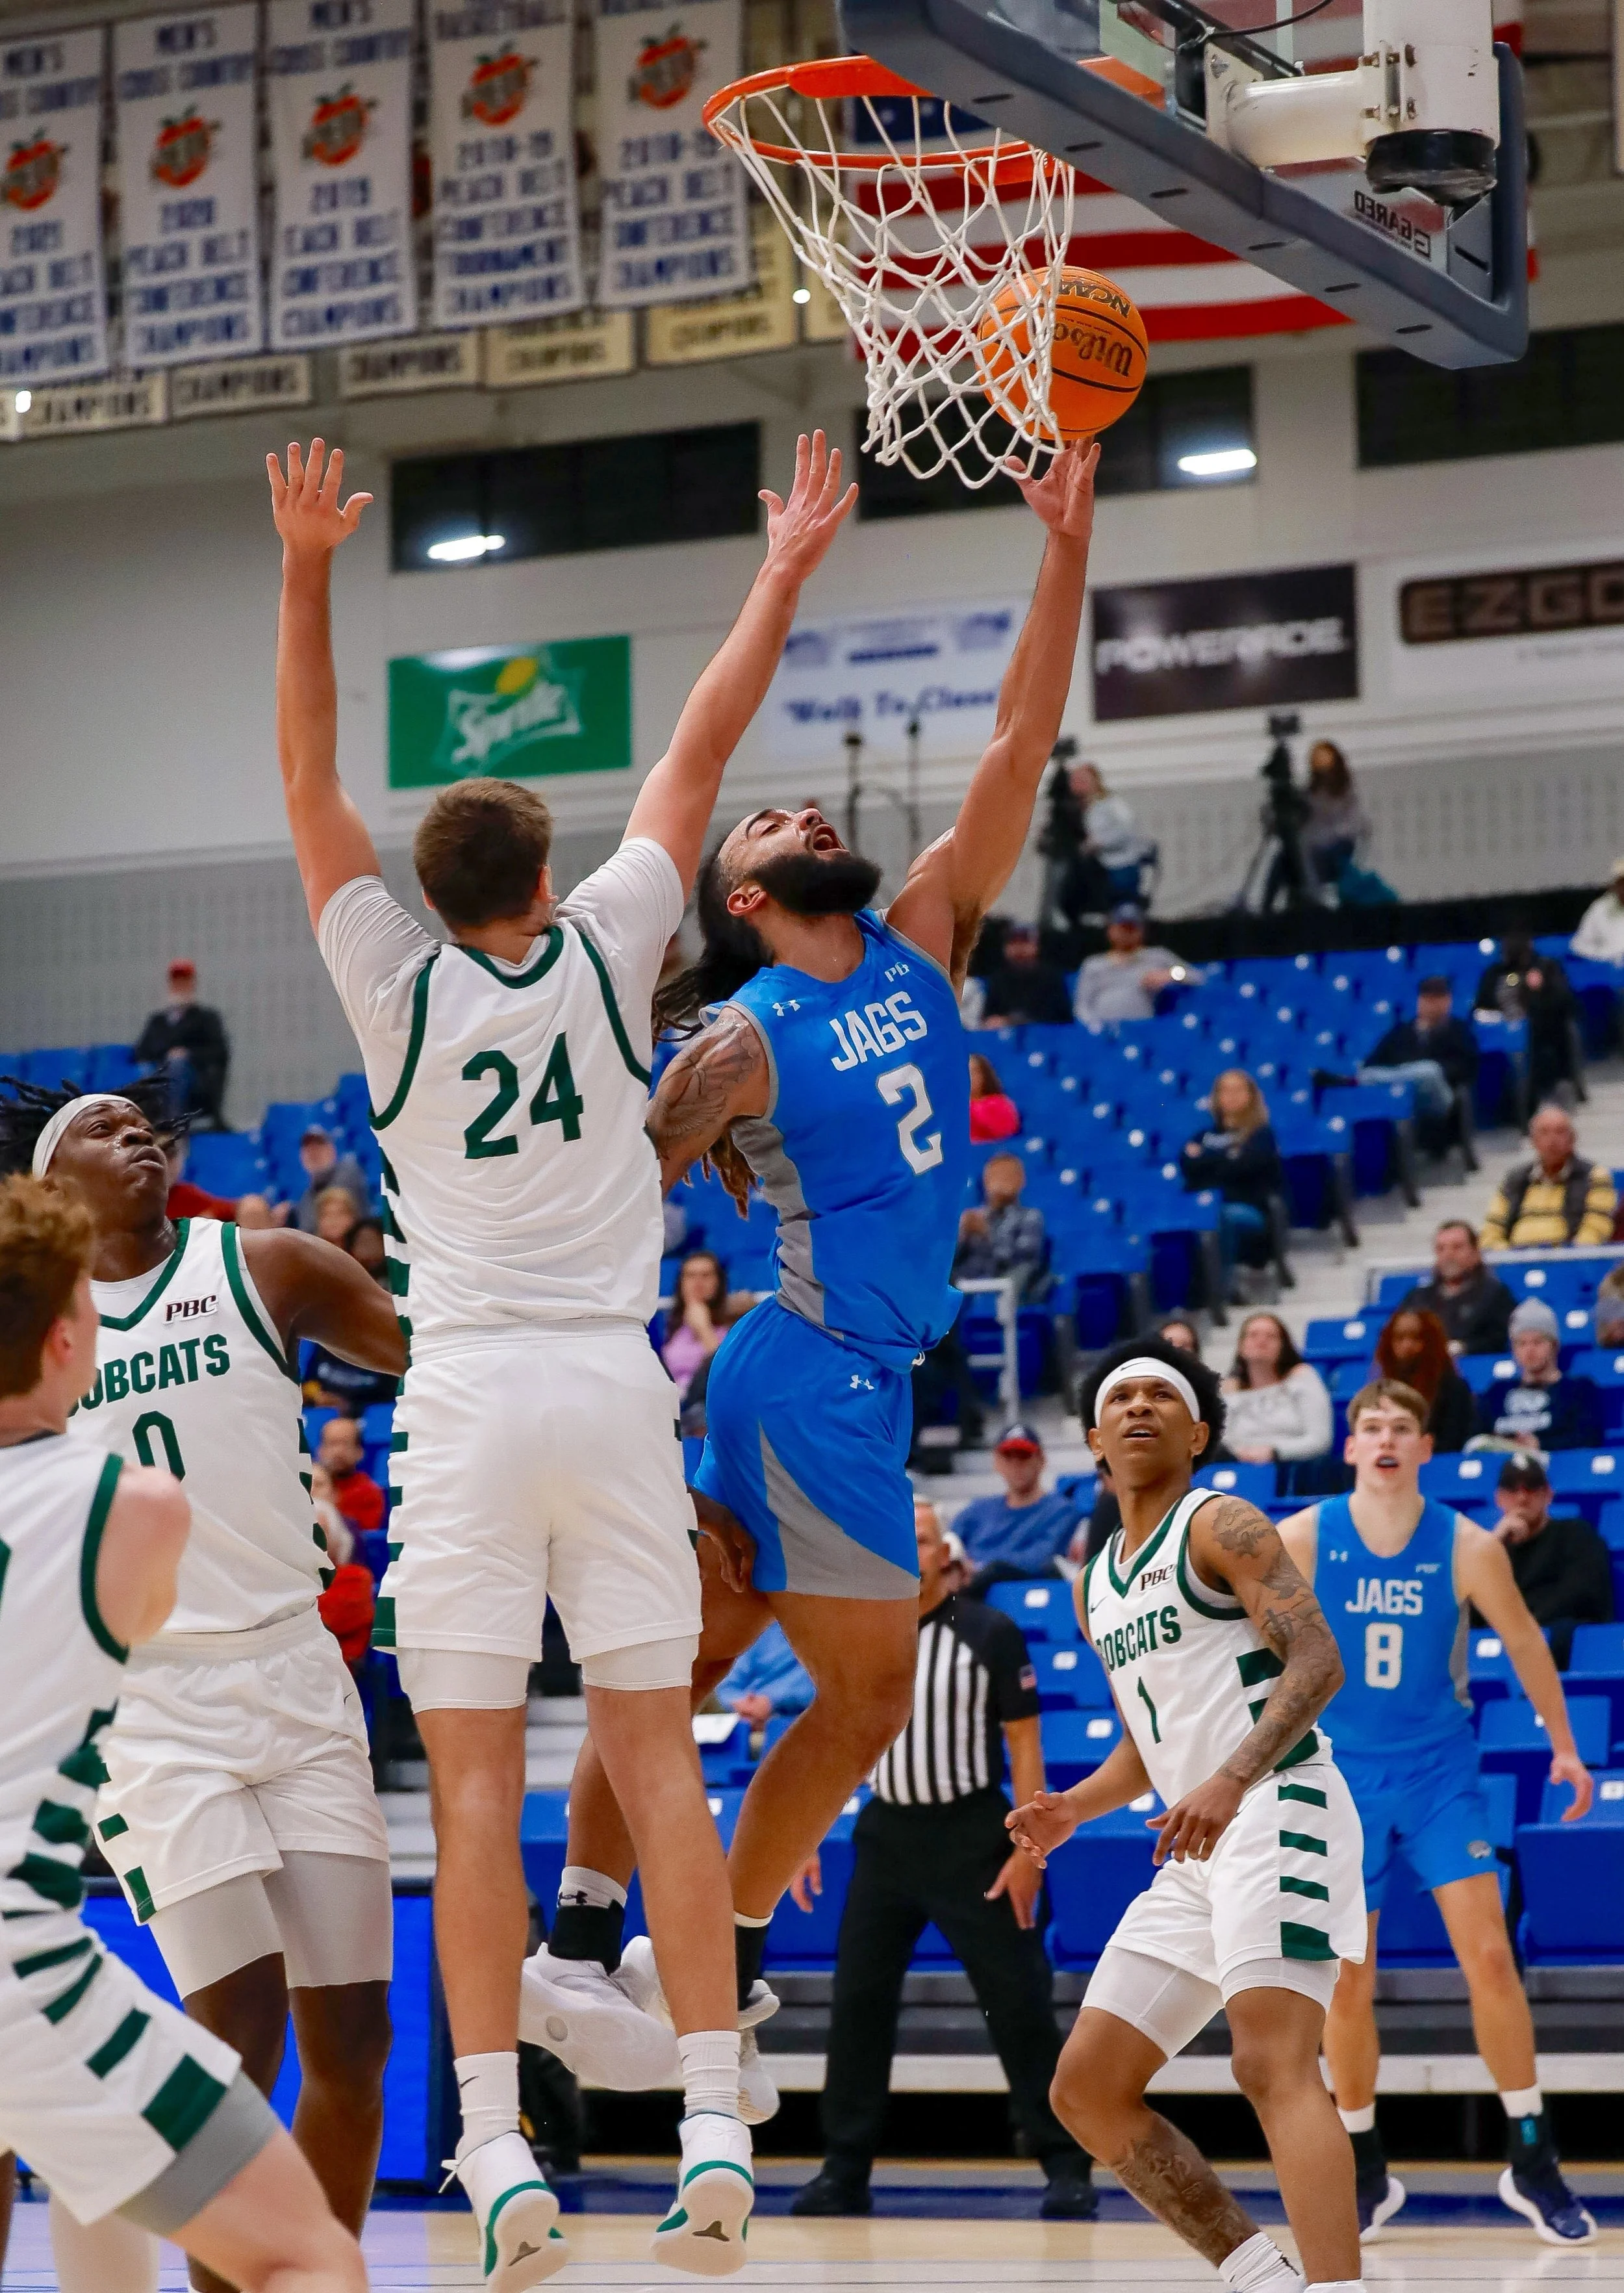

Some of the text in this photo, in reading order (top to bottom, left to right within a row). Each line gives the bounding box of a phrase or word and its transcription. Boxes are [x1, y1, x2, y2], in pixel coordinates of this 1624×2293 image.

[459, 131, 552, 172] 2018-19
[312, 177, 370, 214] 2019
[442, 157, 565, 203] PEACH BELT
[603, 163, 734, 210] PEACH BELT
[353, 209, 400, 246] BELT
[438, 198, 565, 241] CONFERENCE
[129, 228, 247, 274] PEACH BELT
[617, 246, 736, 290] CHAMPIONS
[132, 272, 247, 313] CONFERENCE
[283, 251, 398, 298] CONFERENCE
[446, 274, 570, 315] CHAMPIONS
[282, 294, 401, 338] CHAMPIONS
[1059, 278, 1130, 318] NCAA
[136, 311, 247, 355] CHAMPIONS
[1054, 323, 1132, 377] Wilso
[451, 678, 568, 764] Sprite
[829, 991, 928, 1071] JAGS
[462, 1031, 583, 1160] 24
[877, 1063, 944, 1174] 2
[166, 1295, 217, 1322] PBC
[68, 1333, 231, 1418] OBCATS
[132, 1411, 186, 1483] 0
[1140, 1564, 1174, 1591] PBC
[1345, 1578, 1423, 1616] JAGS
[1365, 1622, 1404, 1689] 8
[1137, 1676, 1162, 1744] 1
